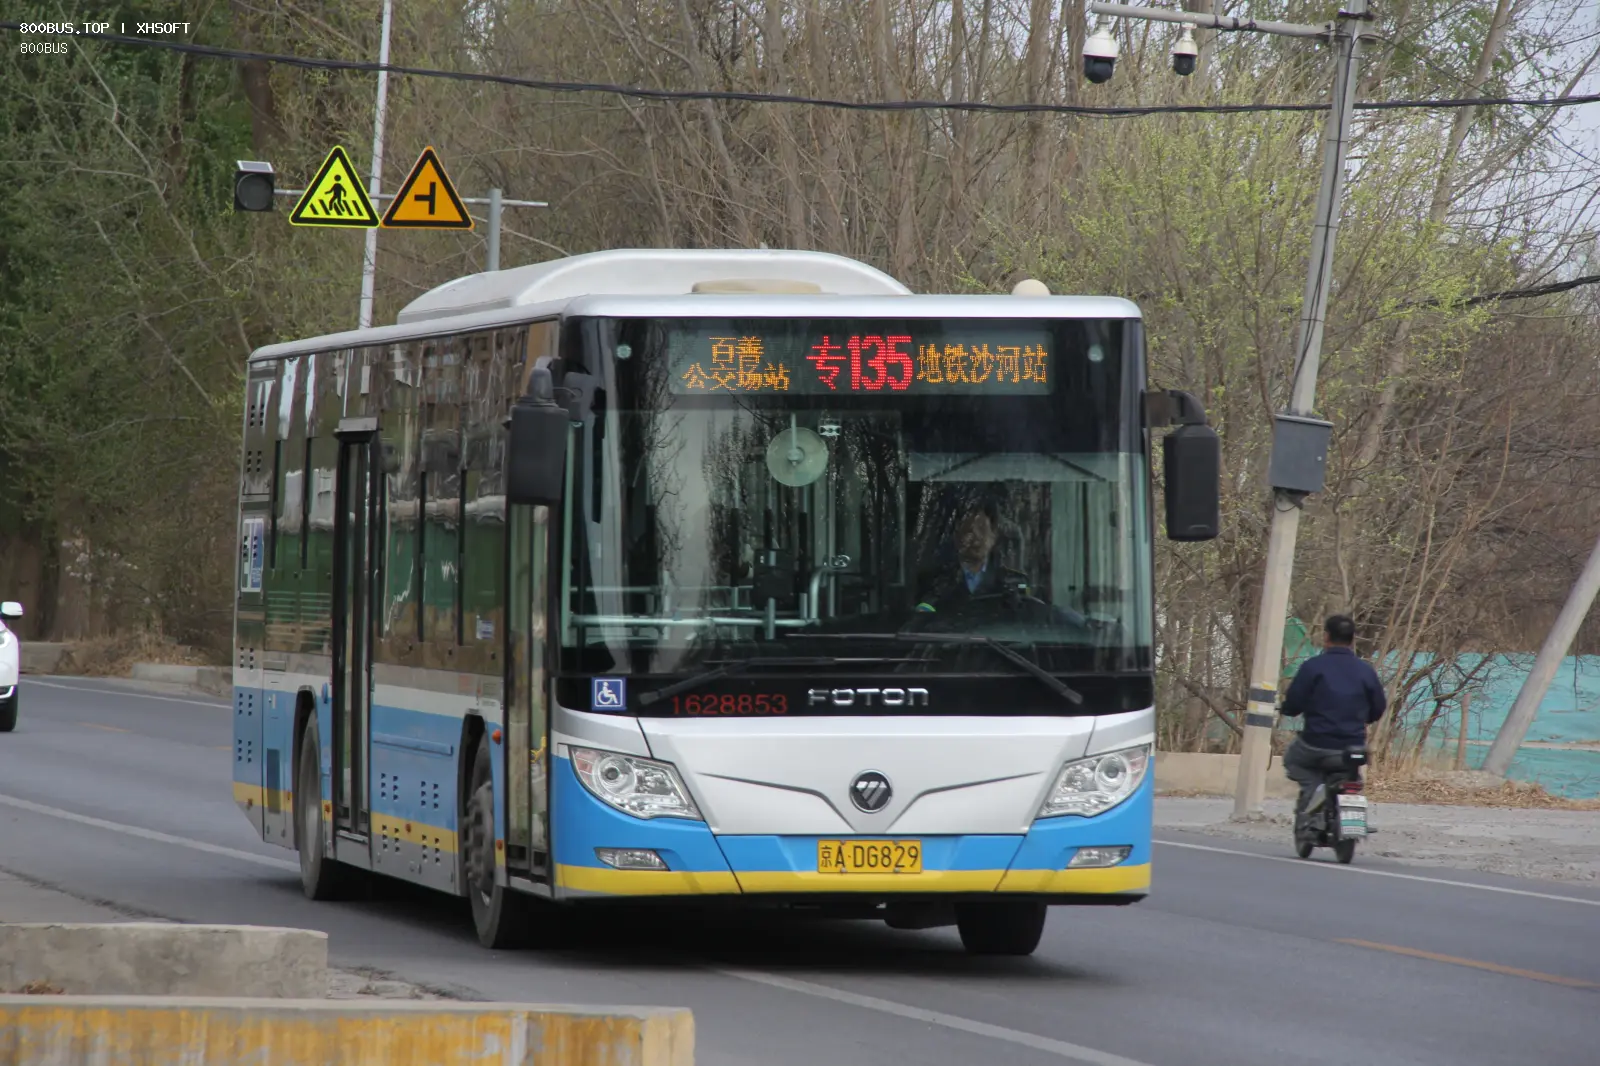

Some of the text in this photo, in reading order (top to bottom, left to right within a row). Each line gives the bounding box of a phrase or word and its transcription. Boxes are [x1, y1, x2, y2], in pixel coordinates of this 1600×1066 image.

[709, 336, 764, 363] 百善
[916, 343, 1048, 383] 地铁沙河站
[682, 362, 789, 391] 公交场站
[672, 694, 788, 715] 1628853
[808, 688, 929, 706] FOTON
